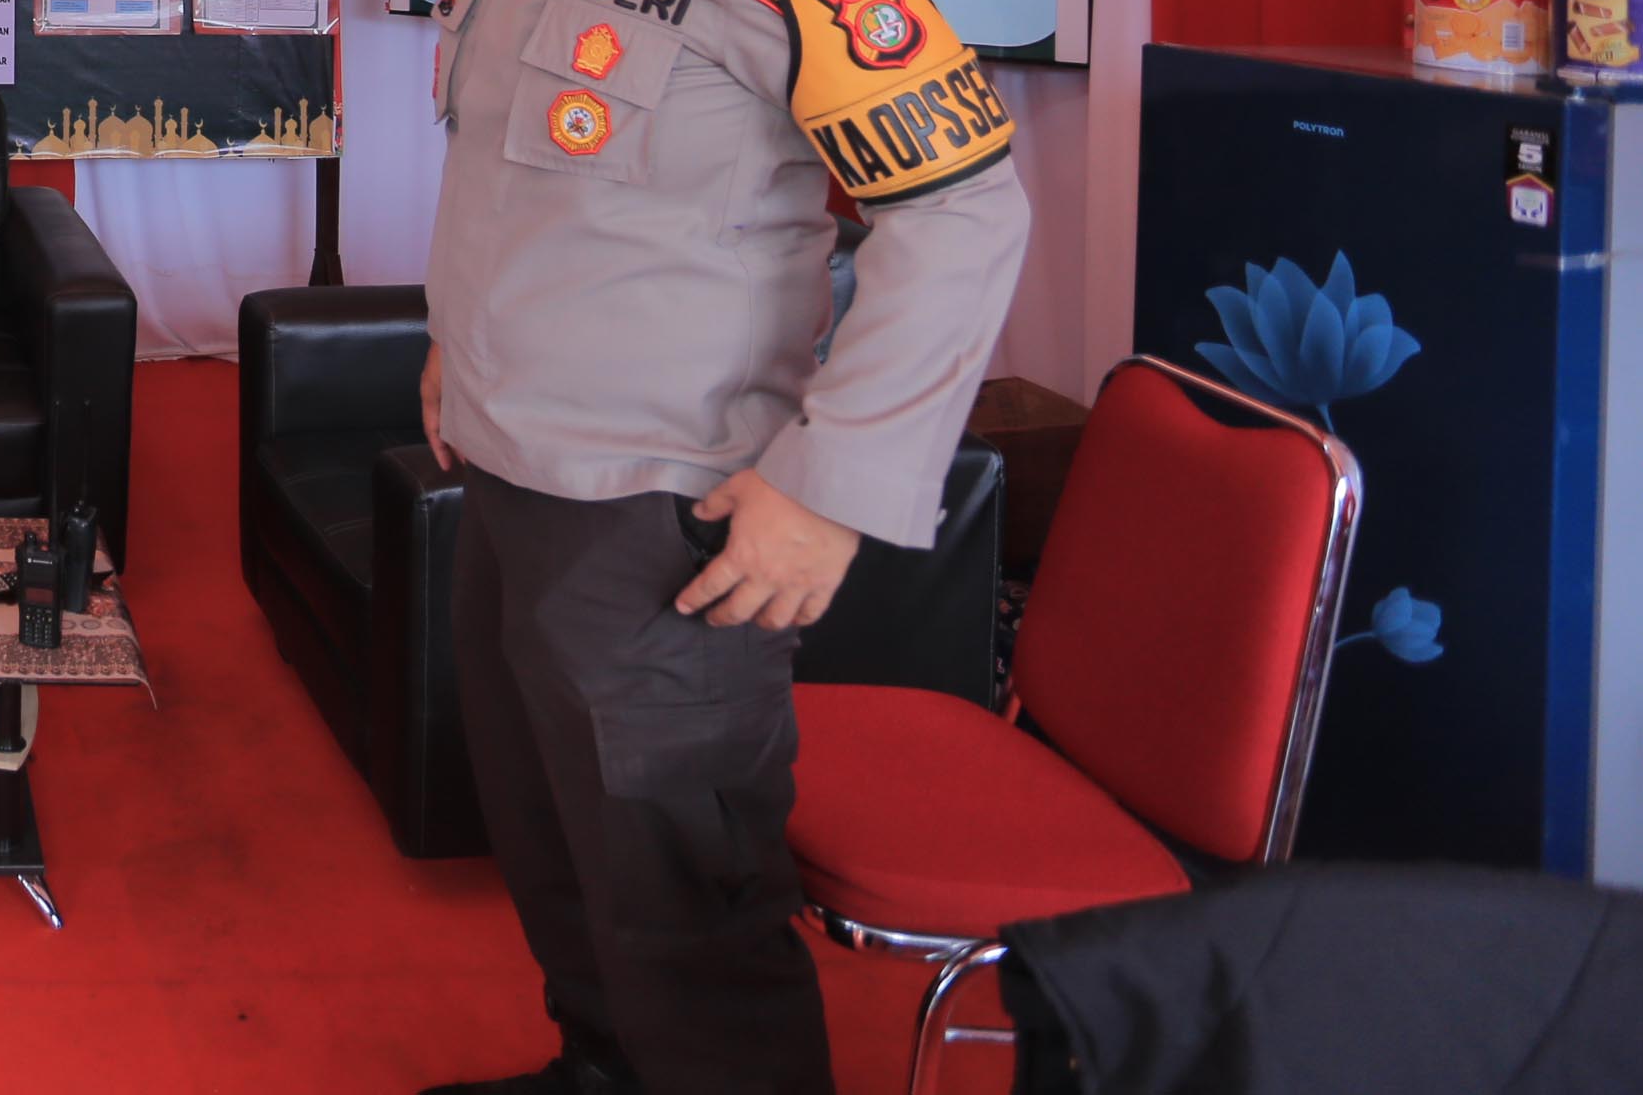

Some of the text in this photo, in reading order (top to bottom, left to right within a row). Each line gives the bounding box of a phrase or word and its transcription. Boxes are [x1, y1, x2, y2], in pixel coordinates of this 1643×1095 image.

[811, 58, 1011, 188] KA OPS SE
[1518, 142, 1543, 163] 5
